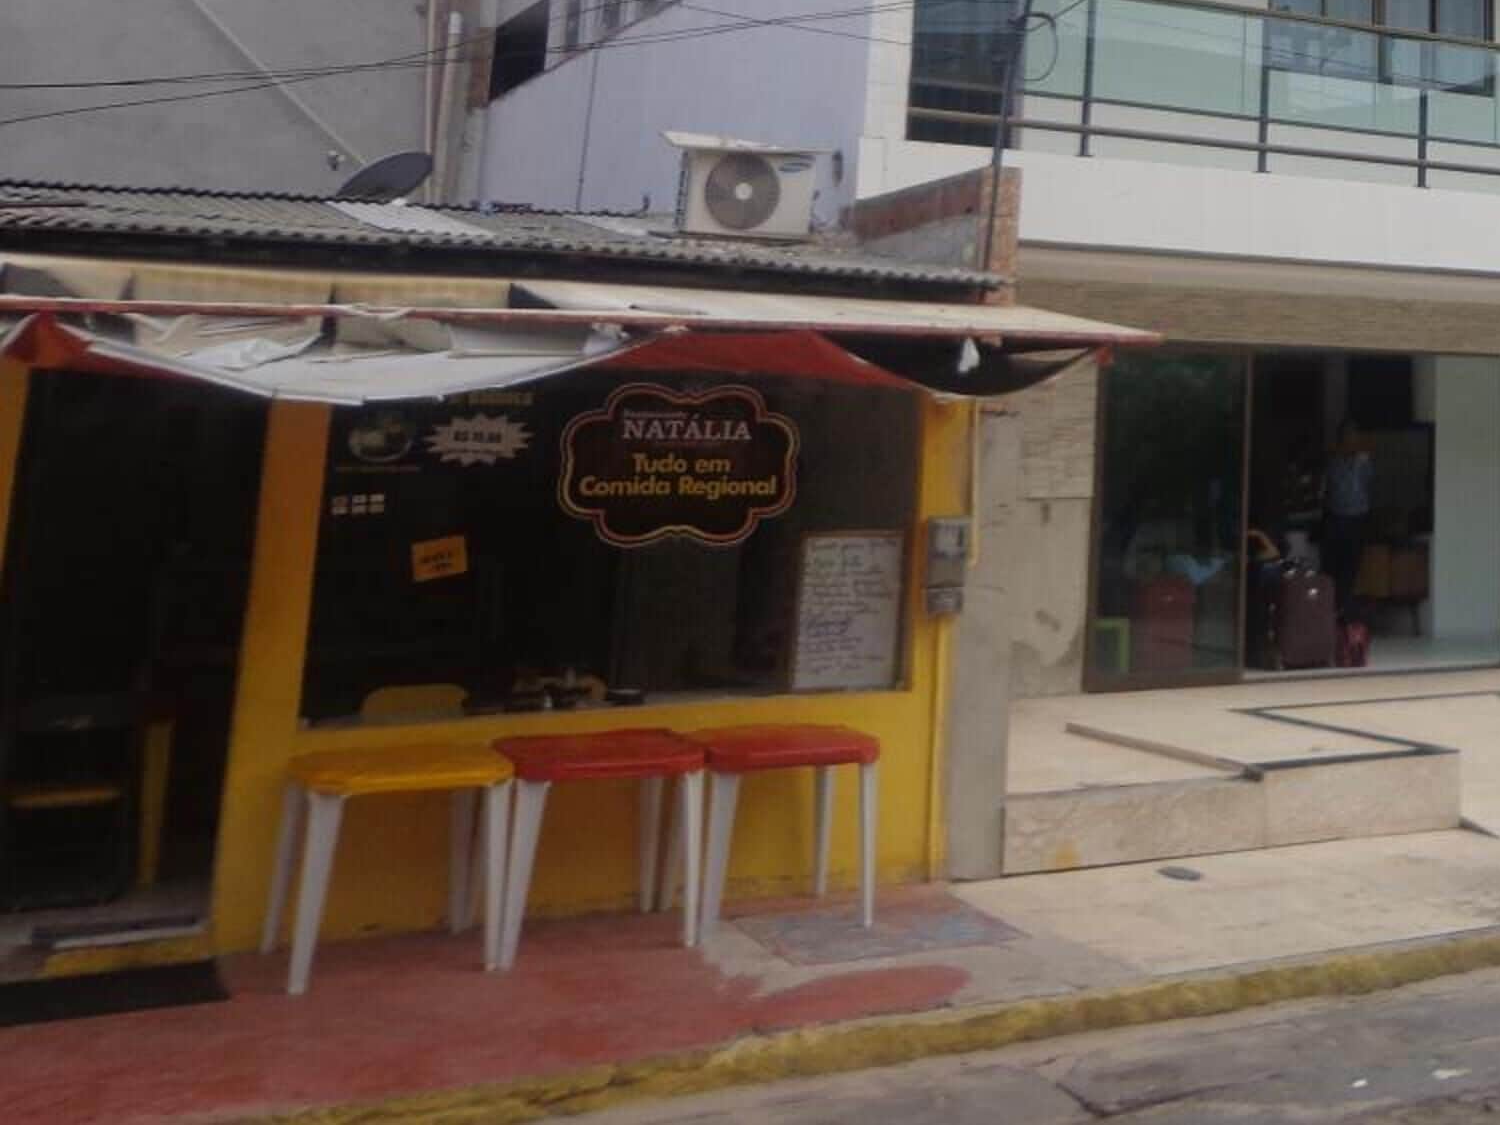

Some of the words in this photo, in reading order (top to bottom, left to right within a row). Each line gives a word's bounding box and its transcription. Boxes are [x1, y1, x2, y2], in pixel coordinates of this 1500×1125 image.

[622, 413, 752, 441] NATÁLIA
[632, 452, 689, 474] Tudo
[695, 458, 731, 474] em
[579, 475, 671, 496] Comida
[679, 475, 777, 499] Regional
